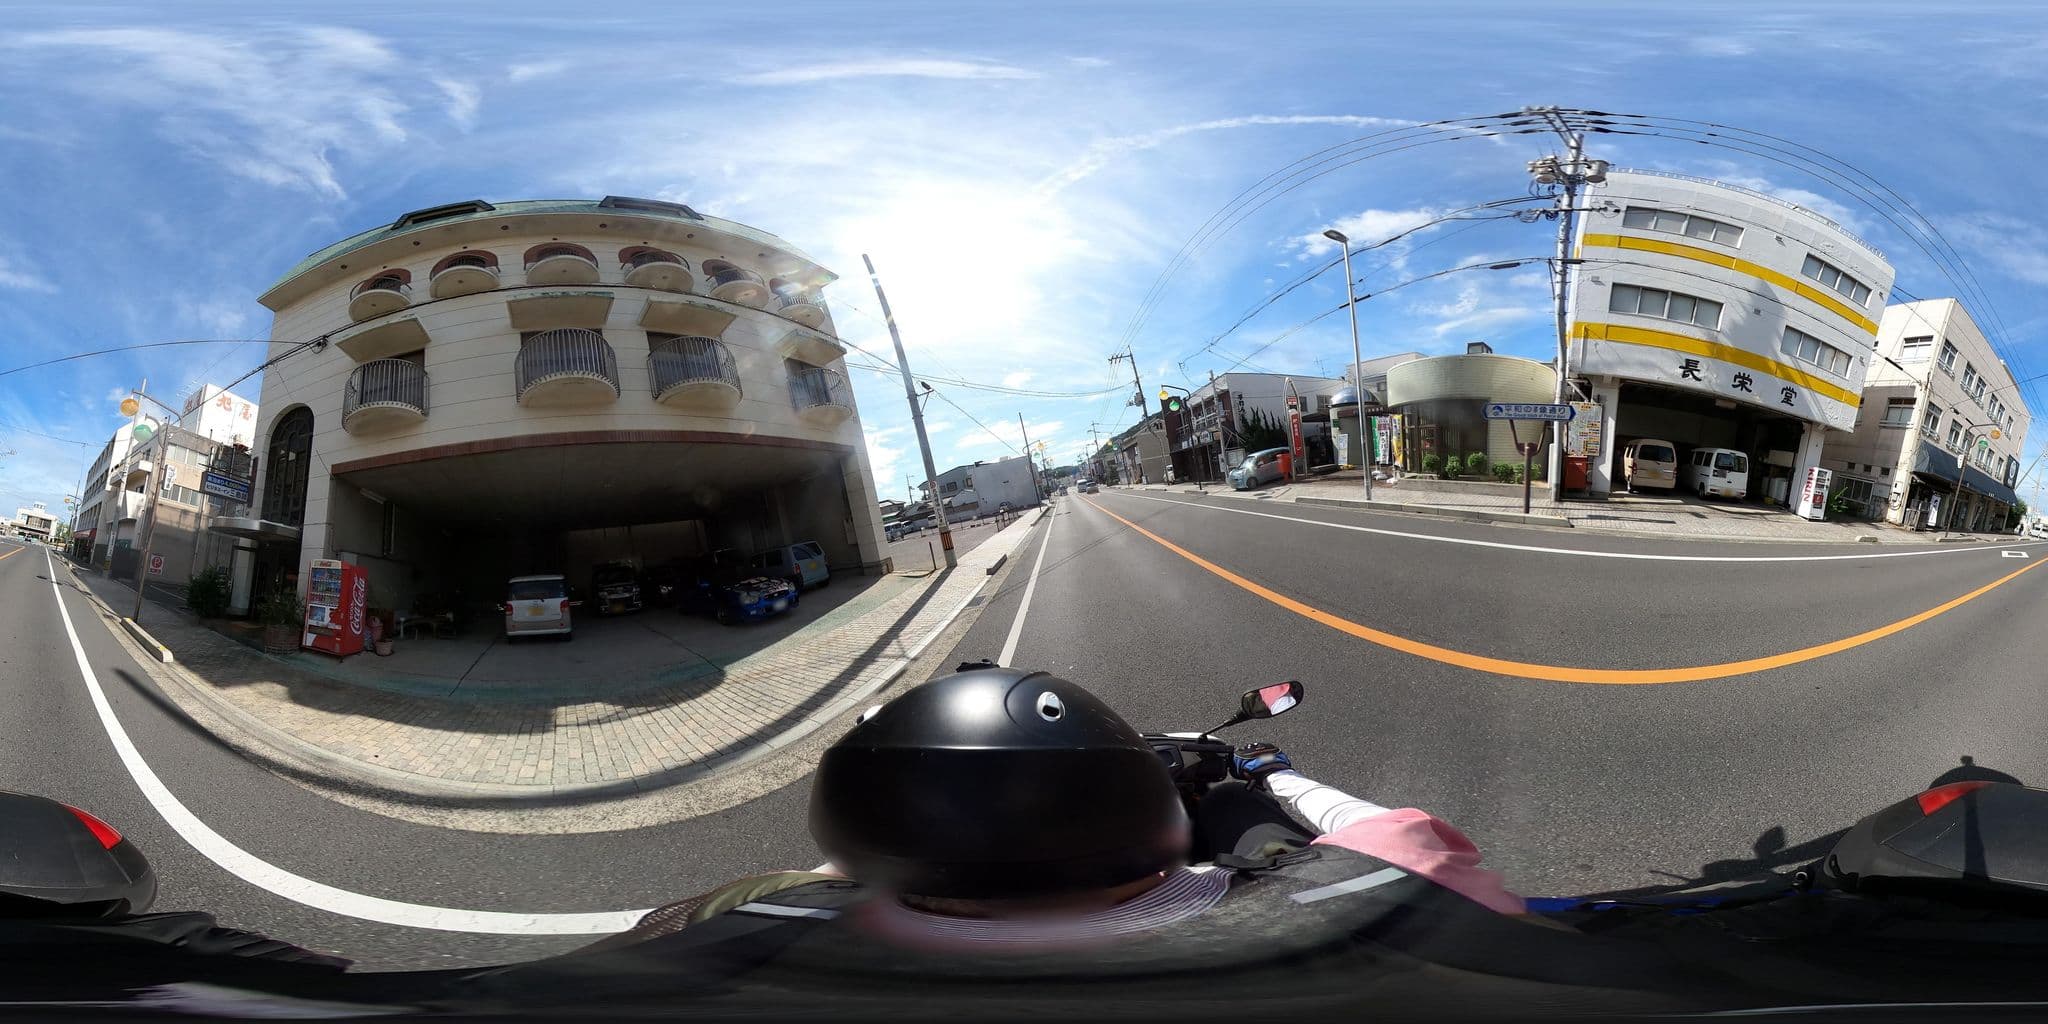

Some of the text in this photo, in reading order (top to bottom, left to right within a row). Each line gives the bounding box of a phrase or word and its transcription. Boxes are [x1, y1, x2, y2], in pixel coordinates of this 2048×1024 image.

[1679, 358, 1798, 407] 長栄堂
[1803, 468, 1814, 502] KIRIN
